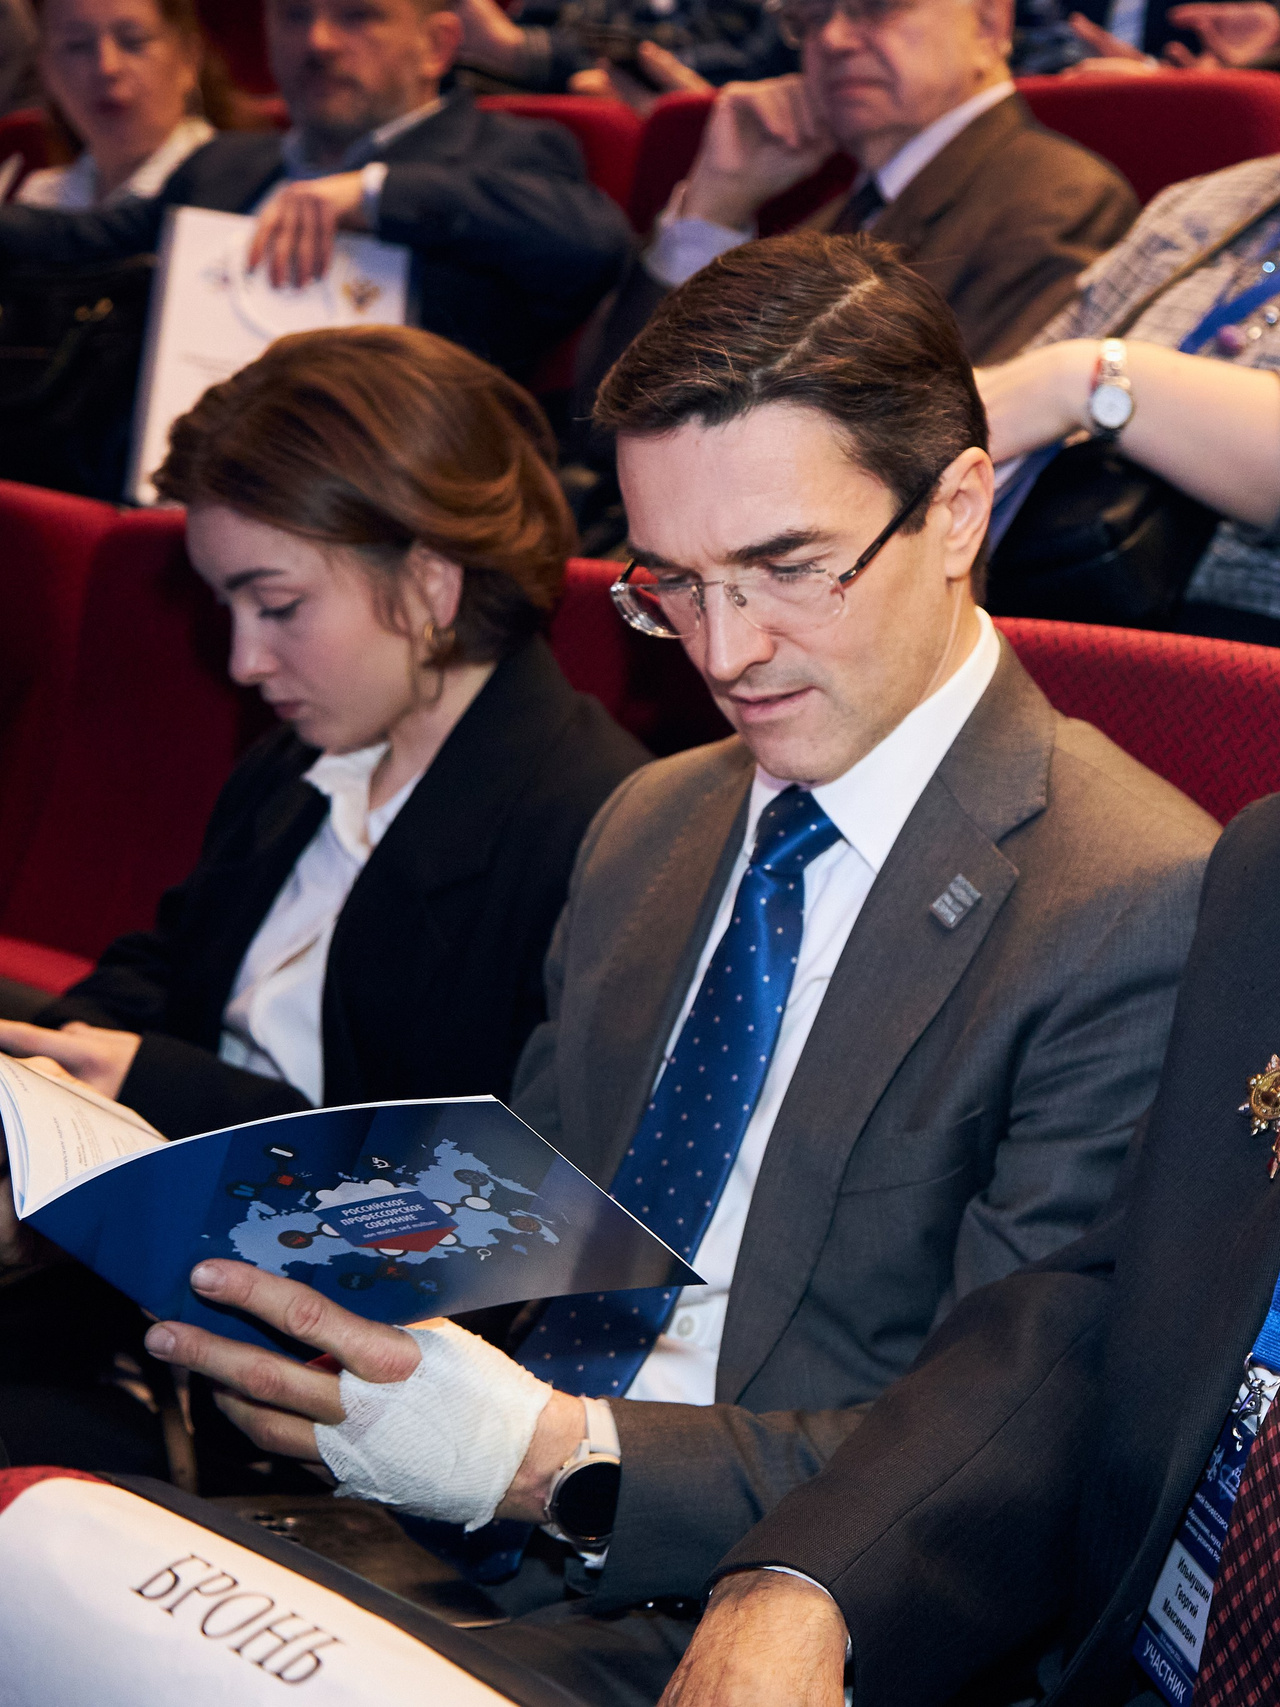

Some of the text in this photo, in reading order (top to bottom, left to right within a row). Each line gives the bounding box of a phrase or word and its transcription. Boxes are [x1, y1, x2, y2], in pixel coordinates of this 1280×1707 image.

[340, 1204, 426, 1226] ПРОФЕССОРСКОЕ
[341, 1198, 408, 1217] РОССИЙСКОЕ
[364, 1213, 419, 1230] СОБРАНИЕ
[130, 1552, 345, 1686] БРОНЬ
[1175, 1583, 1199, 1619] Георгий
[1162, 1597, 1197, 1648] Максимович
[1143, 1640, 1186, 1704] УЧАСТНИК
